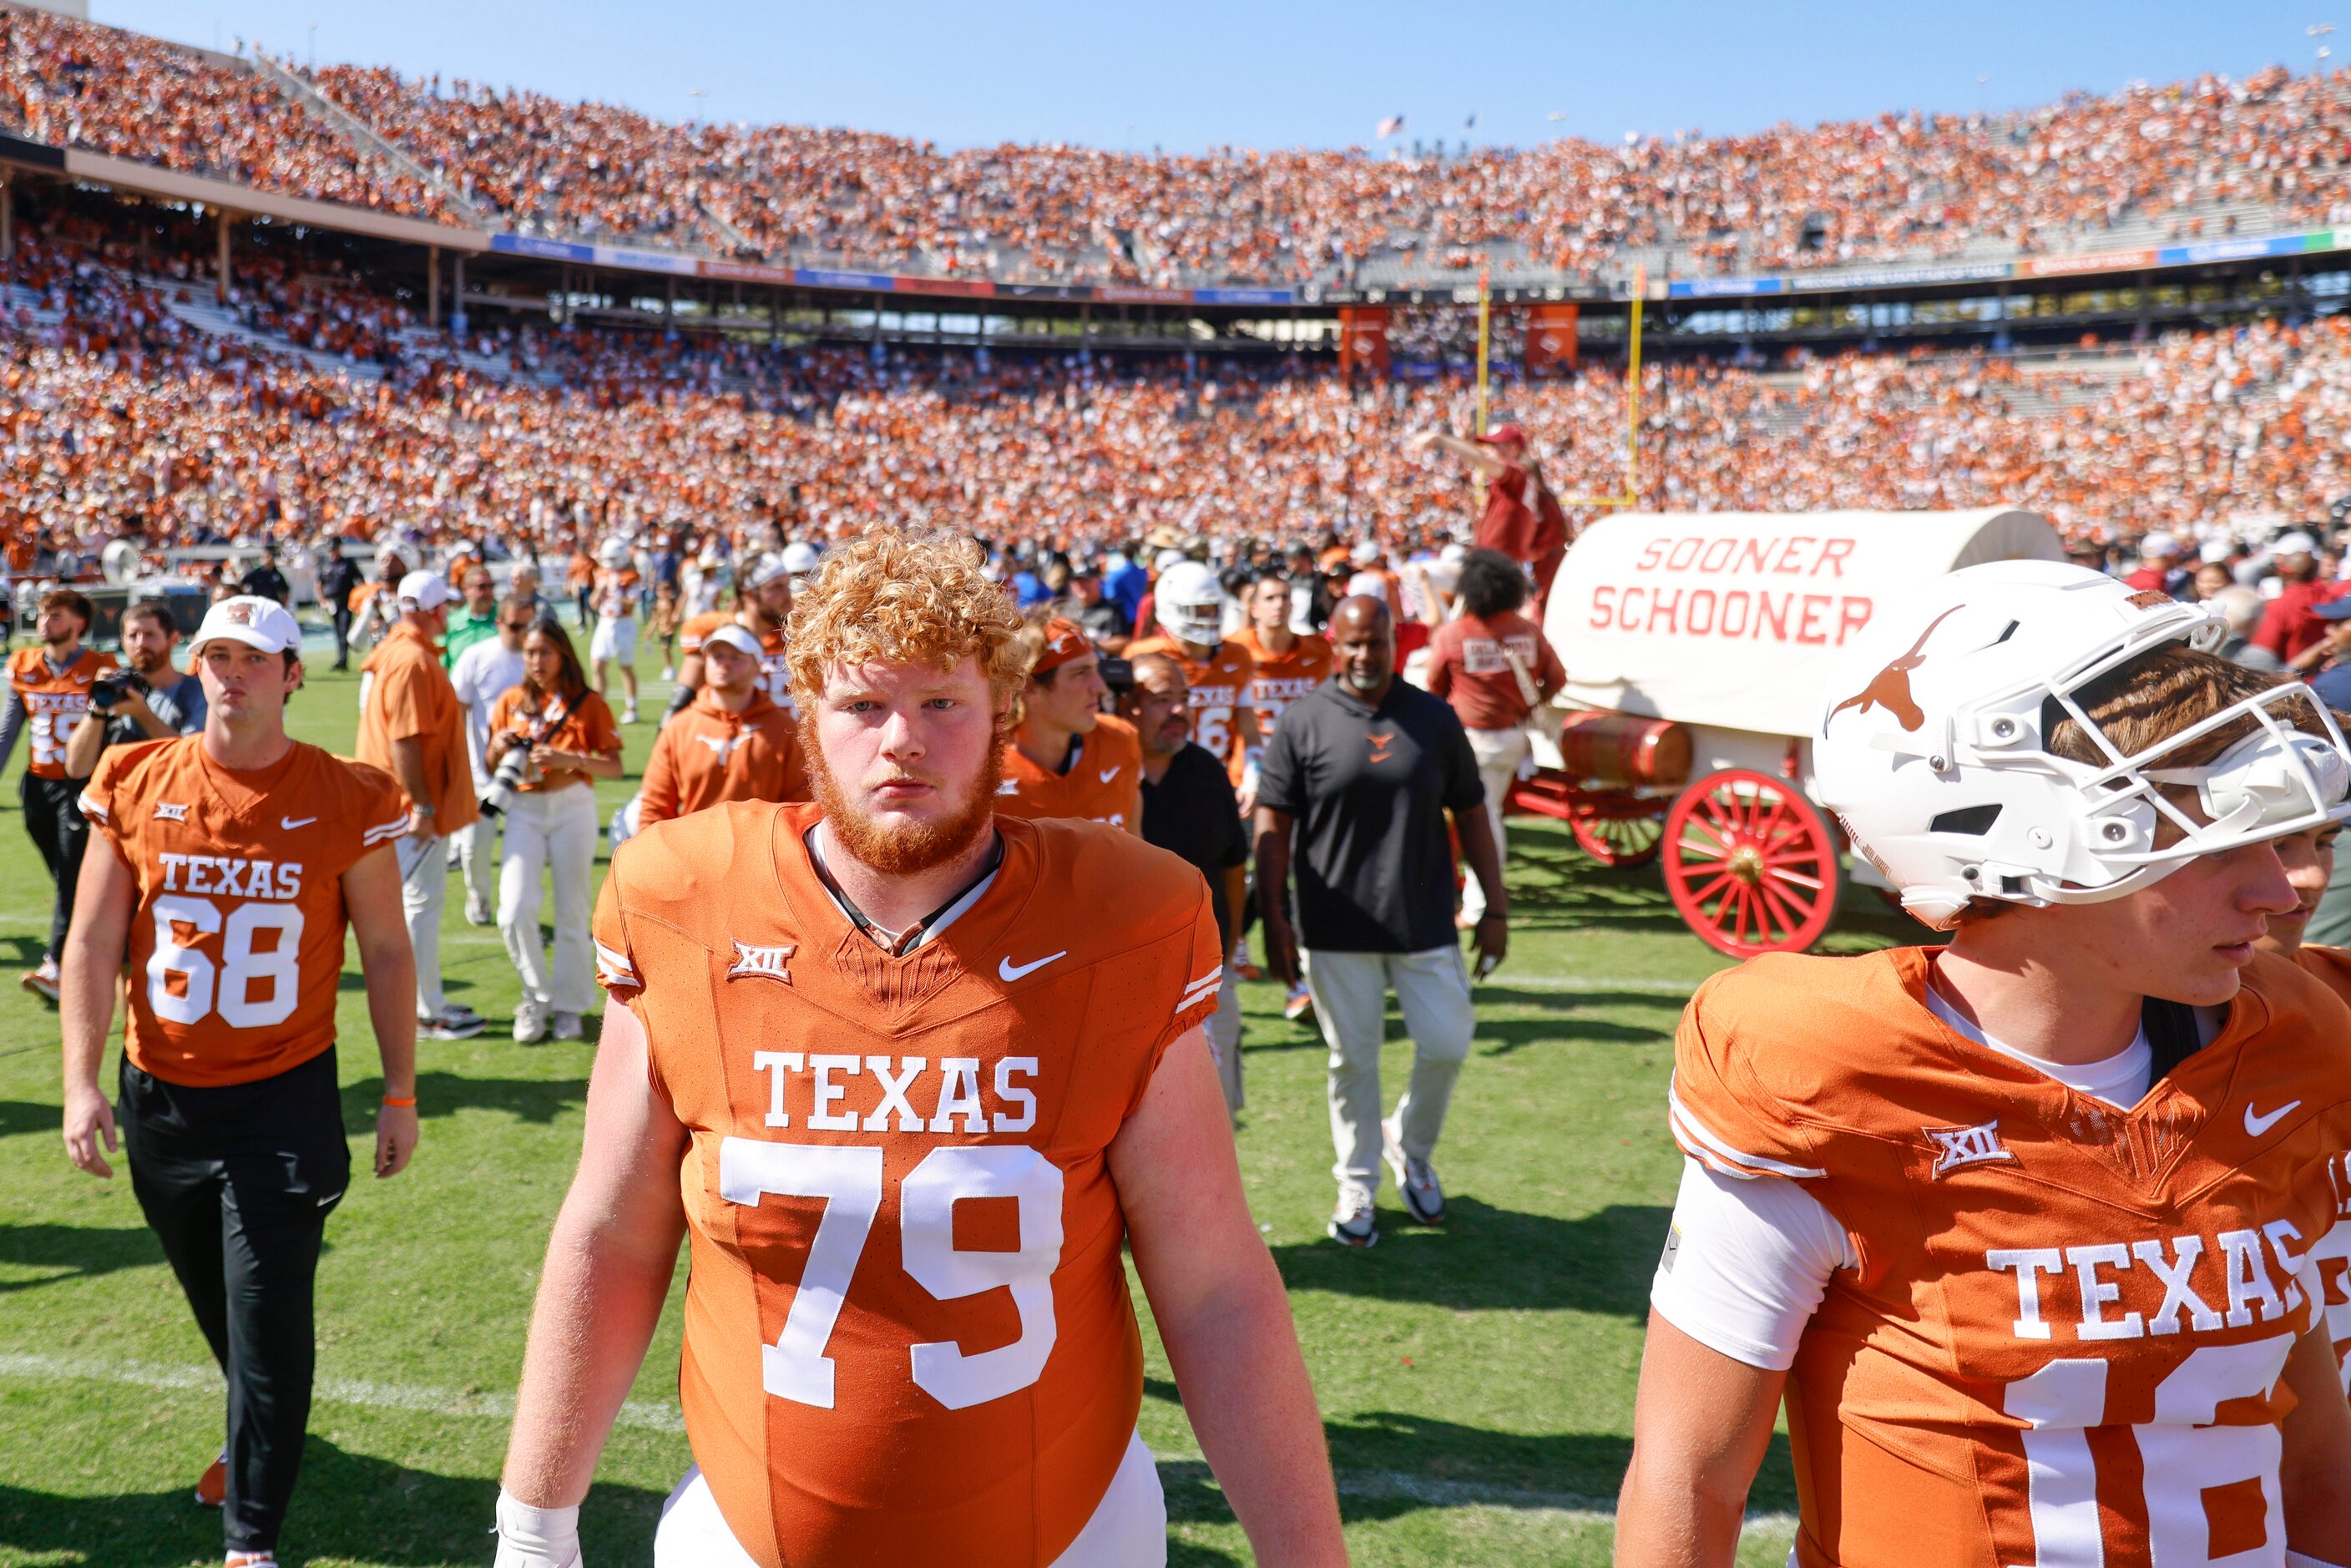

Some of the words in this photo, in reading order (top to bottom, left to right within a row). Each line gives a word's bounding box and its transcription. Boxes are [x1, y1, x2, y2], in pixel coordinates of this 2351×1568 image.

[1637, 537, 1856, 577] SOONER
[1590, 586, 1873, 646] SCHOONER
[24, 691, 88, 713] TEXAS
[1188, 685, 1236, 706] EXAS
[159, 852, 303, 899] TEXAS
[146, 893, 305, 1029] 68
[730, 941, 794, 980] XII
[754, 1050, 1039, 1133] TEXAS
[1930, 1119, 2013, 1171] XII
[720, 1136, 1064, 1410] 79
[1986, 1219, 2307, 1341] TEXAS
[2004, 1332, 2297, 1568] 16
